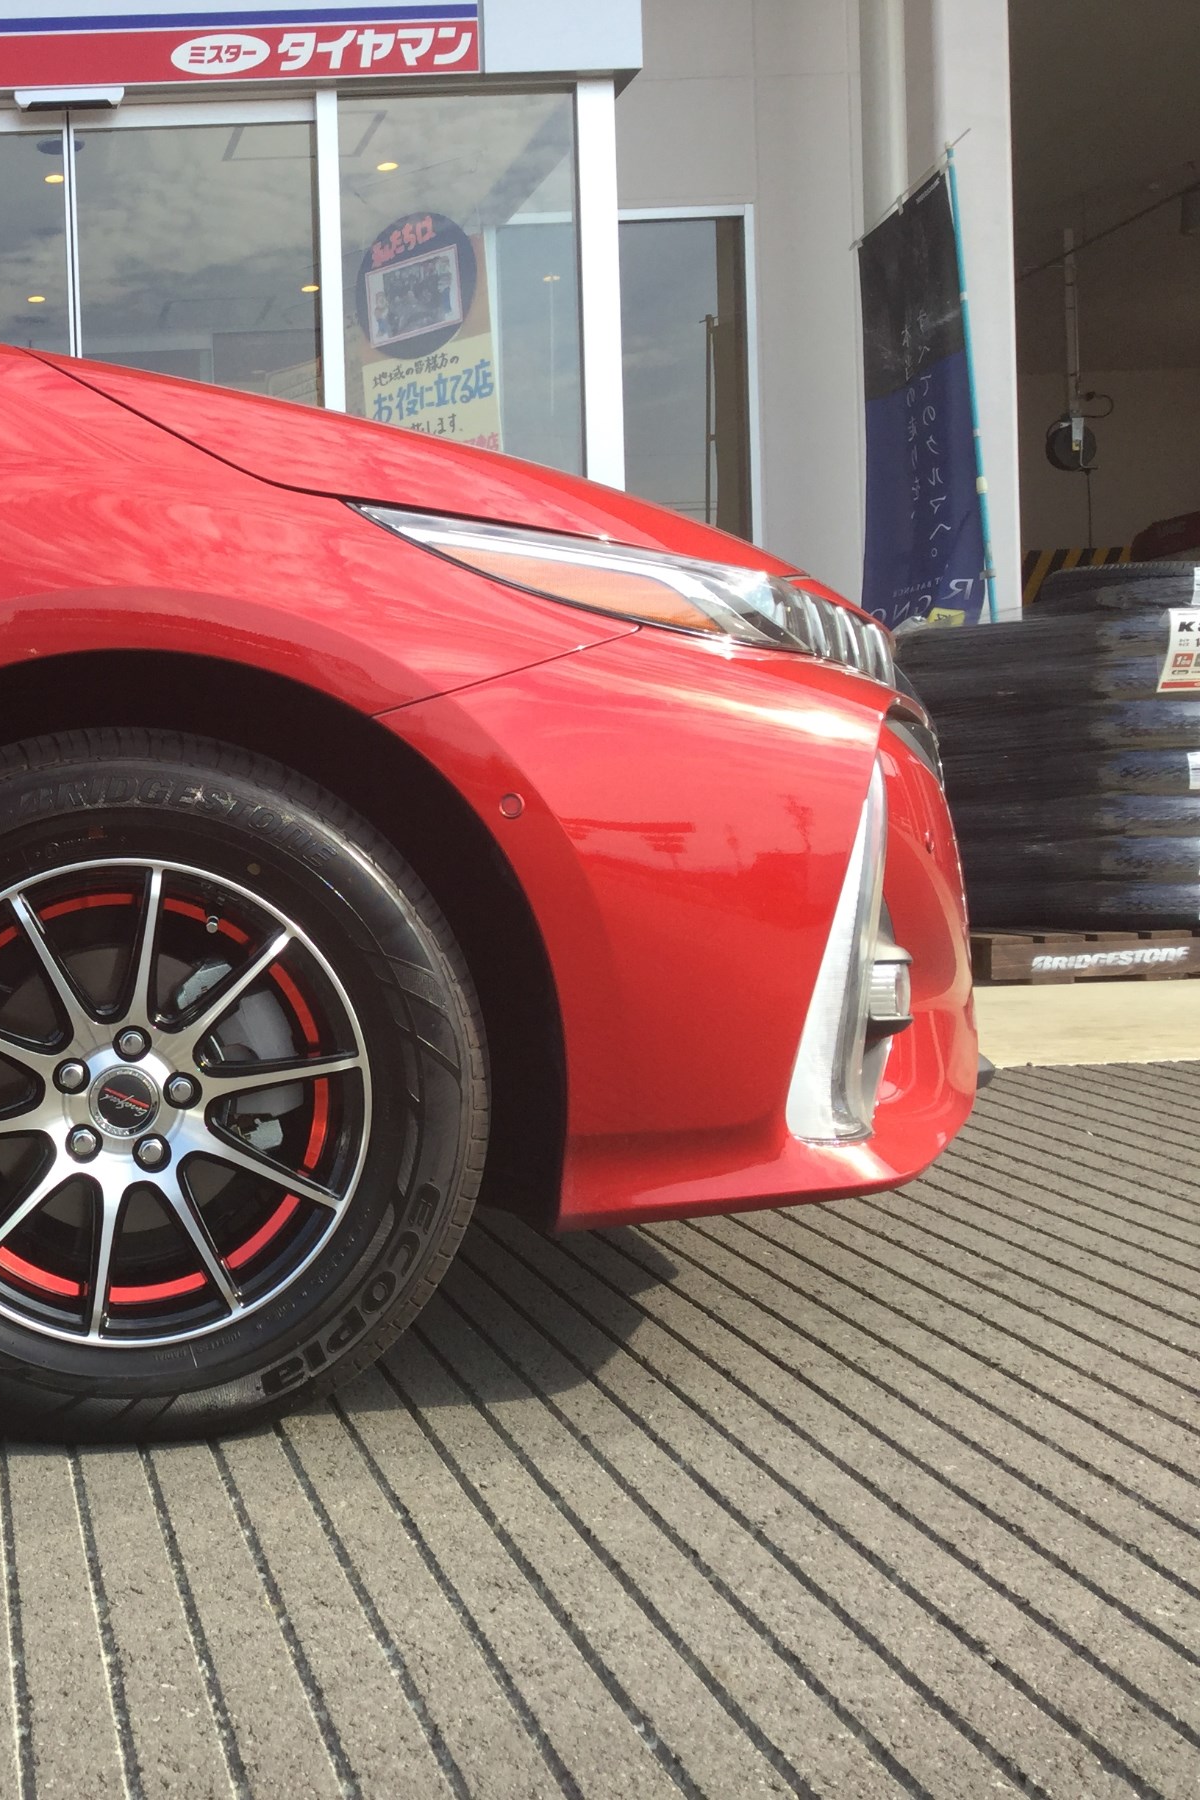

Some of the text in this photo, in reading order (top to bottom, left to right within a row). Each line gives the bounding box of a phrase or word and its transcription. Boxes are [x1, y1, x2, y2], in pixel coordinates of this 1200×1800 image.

[188, 27, 472, 71] ミスター タイヤマン
[372, 352, 460, 388] 地域の皆様方の
[373, 359, 495, 423] お役に立てる店
[15, 776, 338, 868] BRIDGESTONE
[1031, 946, 1191, 972] BRIDGESTONE
